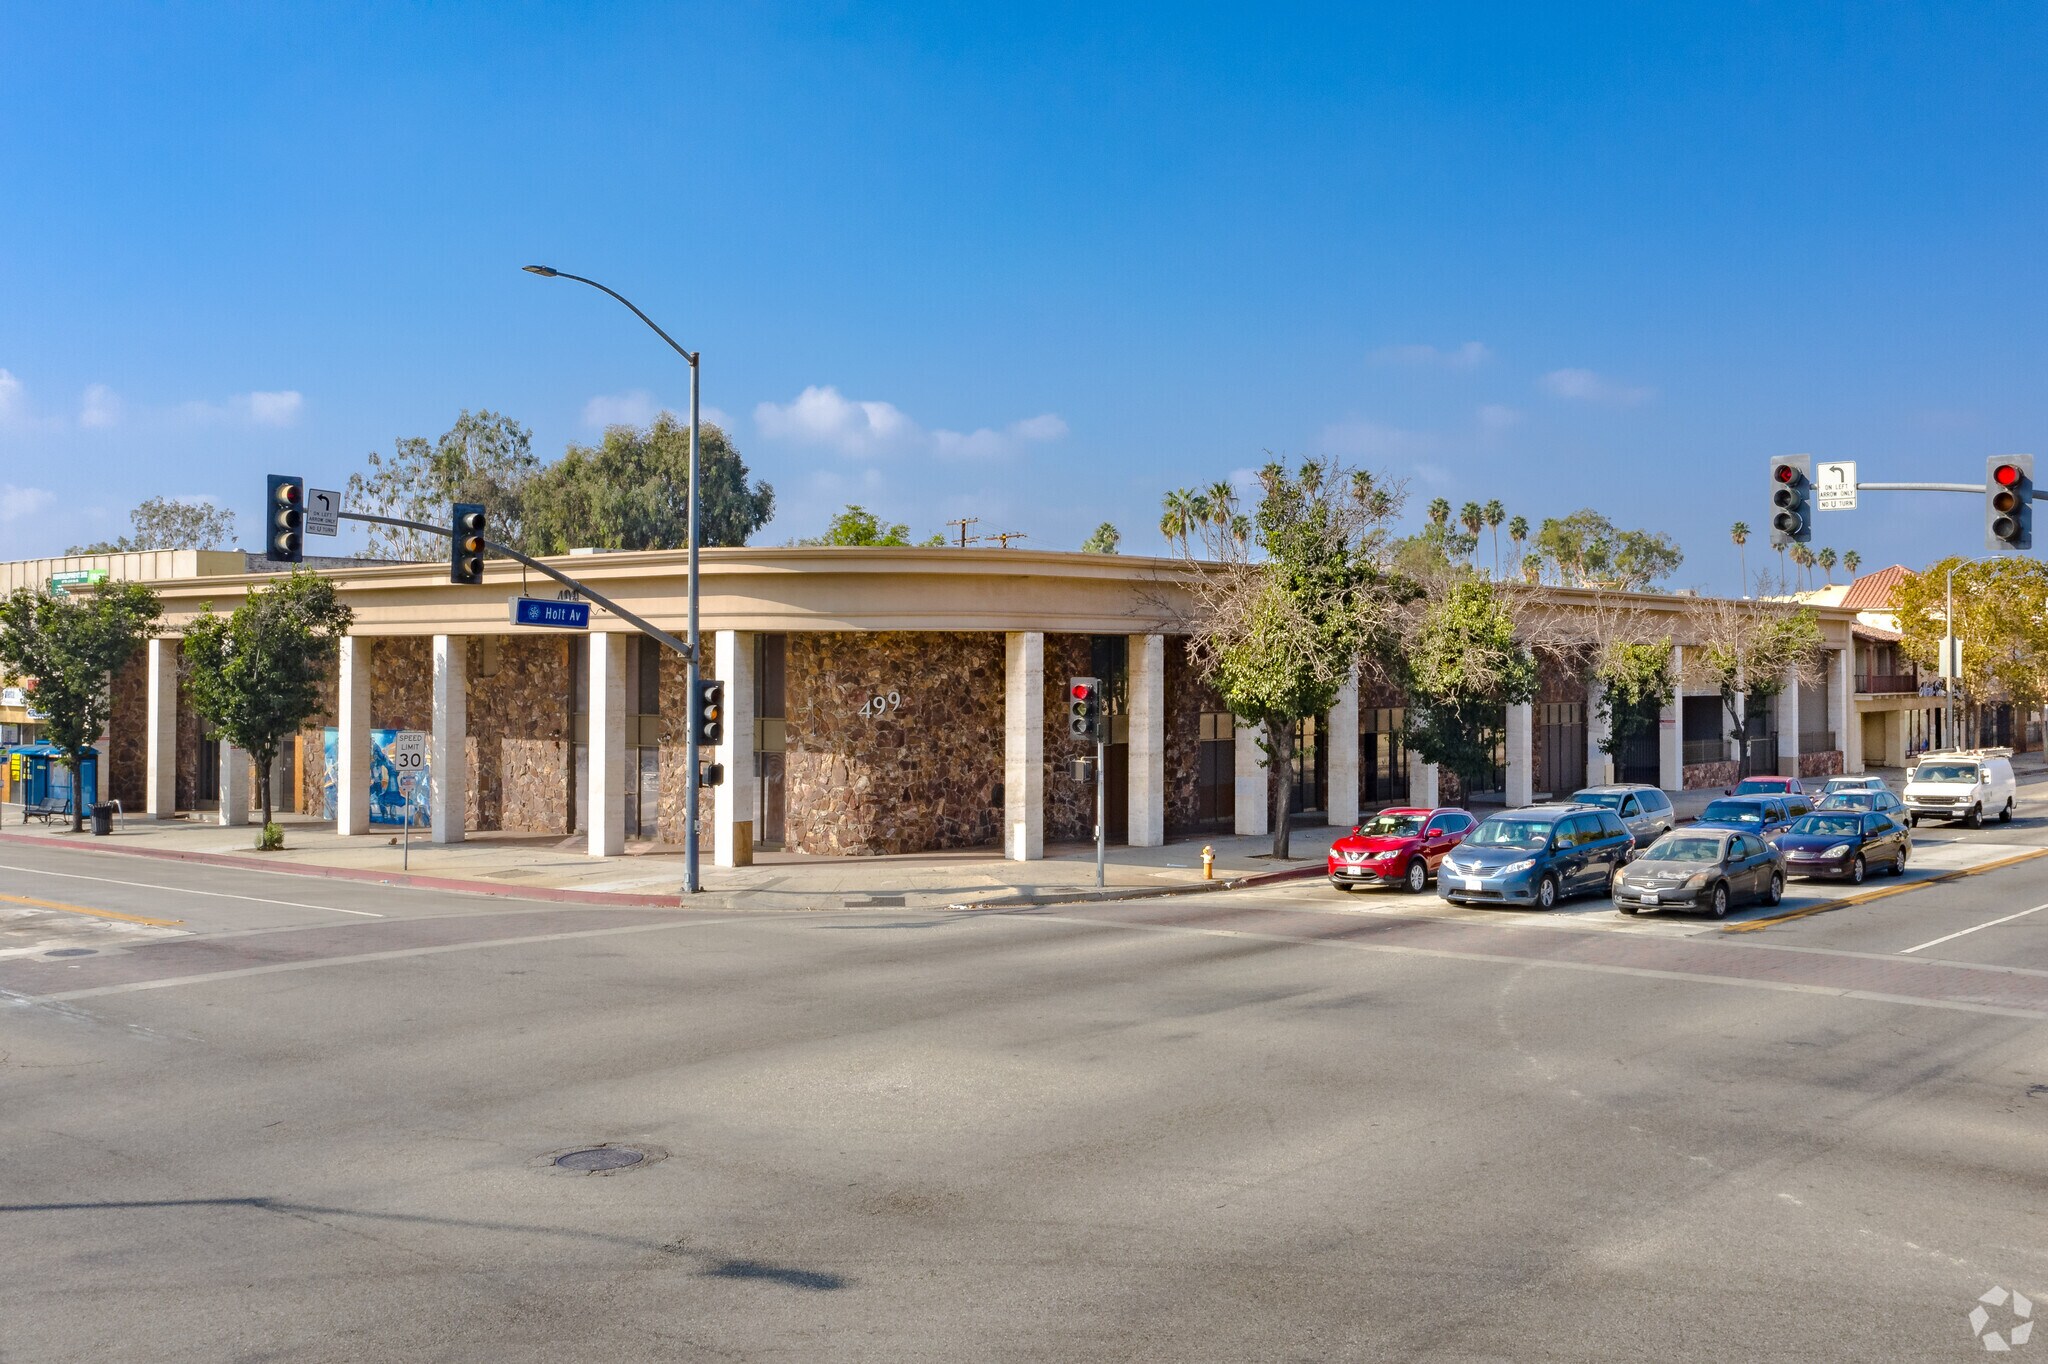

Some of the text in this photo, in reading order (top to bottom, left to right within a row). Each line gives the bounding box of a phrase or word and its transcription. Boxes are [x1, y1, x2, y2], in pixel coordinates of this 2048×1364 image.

[1830, 500, 1837, 508] U
[545, 607, 581, 621] Holt Av
[857, 691, 901, 719] 499
[399, 734, 422, 742] SPEED
[401, 743, 420, 751] LIMIT
[398, 753, 421, 768] 30
